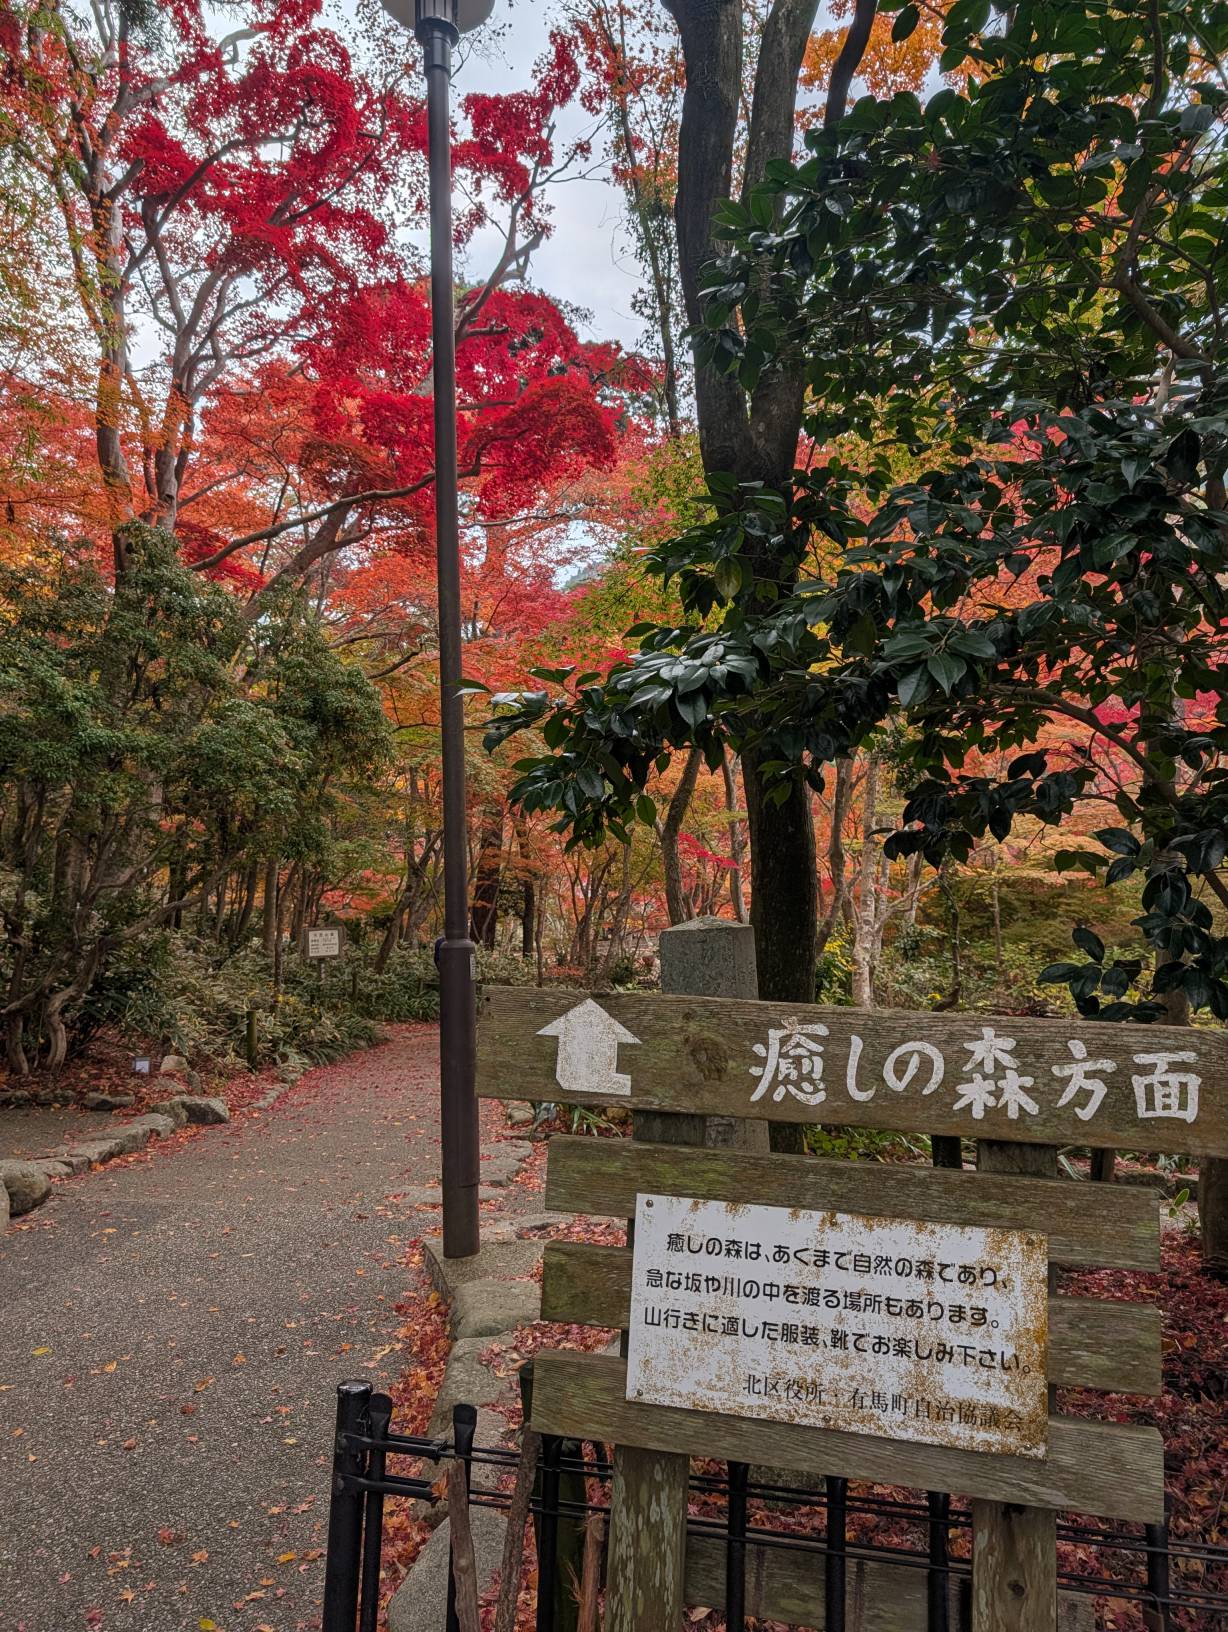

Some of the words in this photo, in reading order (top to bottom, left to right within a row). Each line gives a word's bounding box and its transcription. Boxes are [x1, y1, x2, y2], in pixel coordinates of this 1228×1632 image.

[749, 1016, 1202, 1124] 癒しの森方面
[666, 1232, 1008, 1289] 癒しの森は、あくまで自然の森であり、
[645, 1268, 1000, 1329] 急な坂や川の中を渡る場所もあります。
[643, 1306, 1031, 1375] 山行きに適した服装、靴でお楽しみ下さい。
